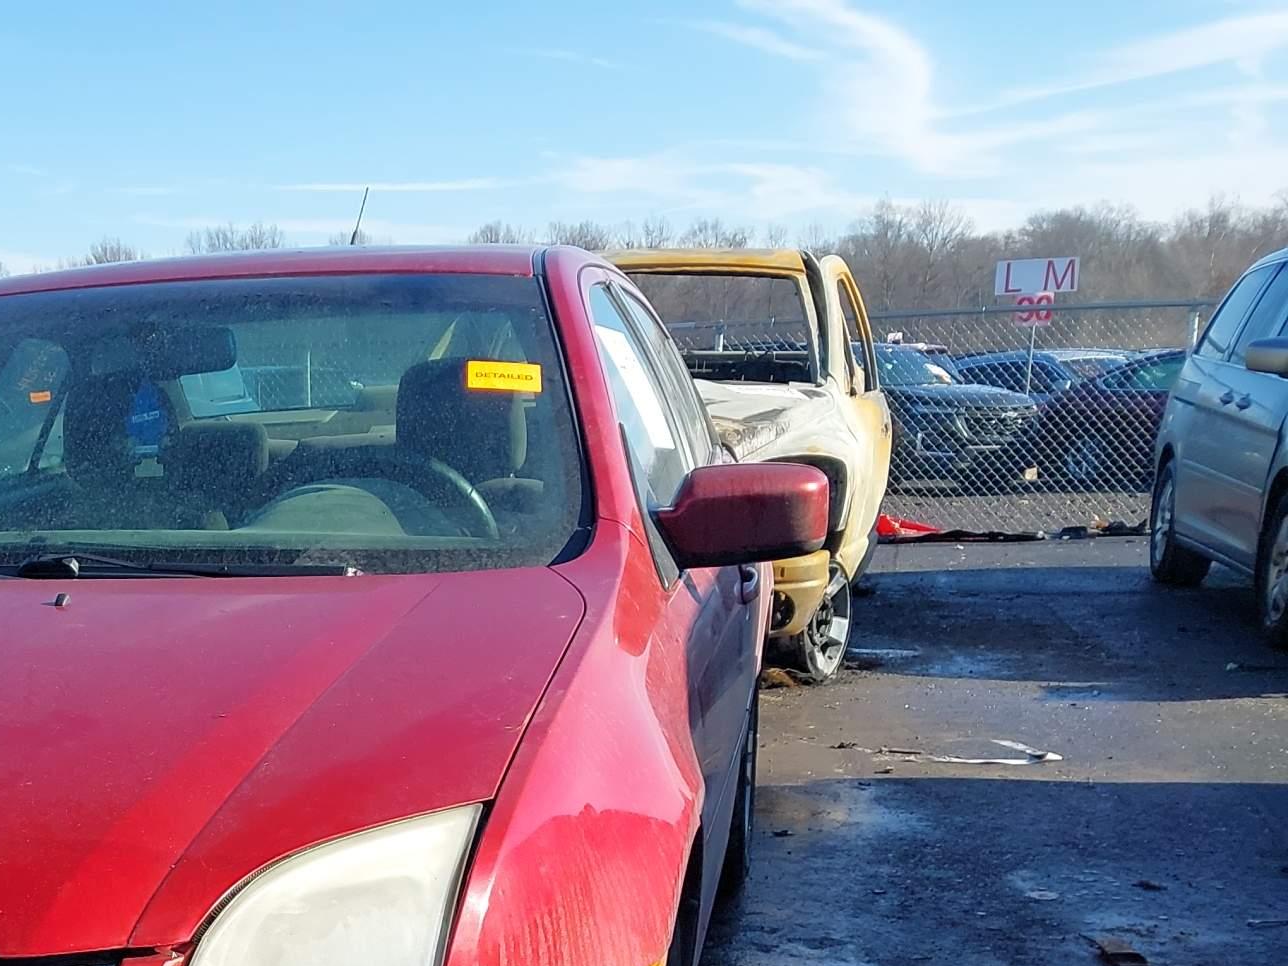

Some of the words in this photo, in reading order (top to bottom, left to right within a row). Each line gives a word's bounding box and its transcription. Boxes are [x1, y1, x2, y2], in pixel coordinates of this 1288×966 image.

[1004, 261, 1023, 294] L
[1042, 258, 1076, 291] M
[475, 371, 534, 381] DETAILED
